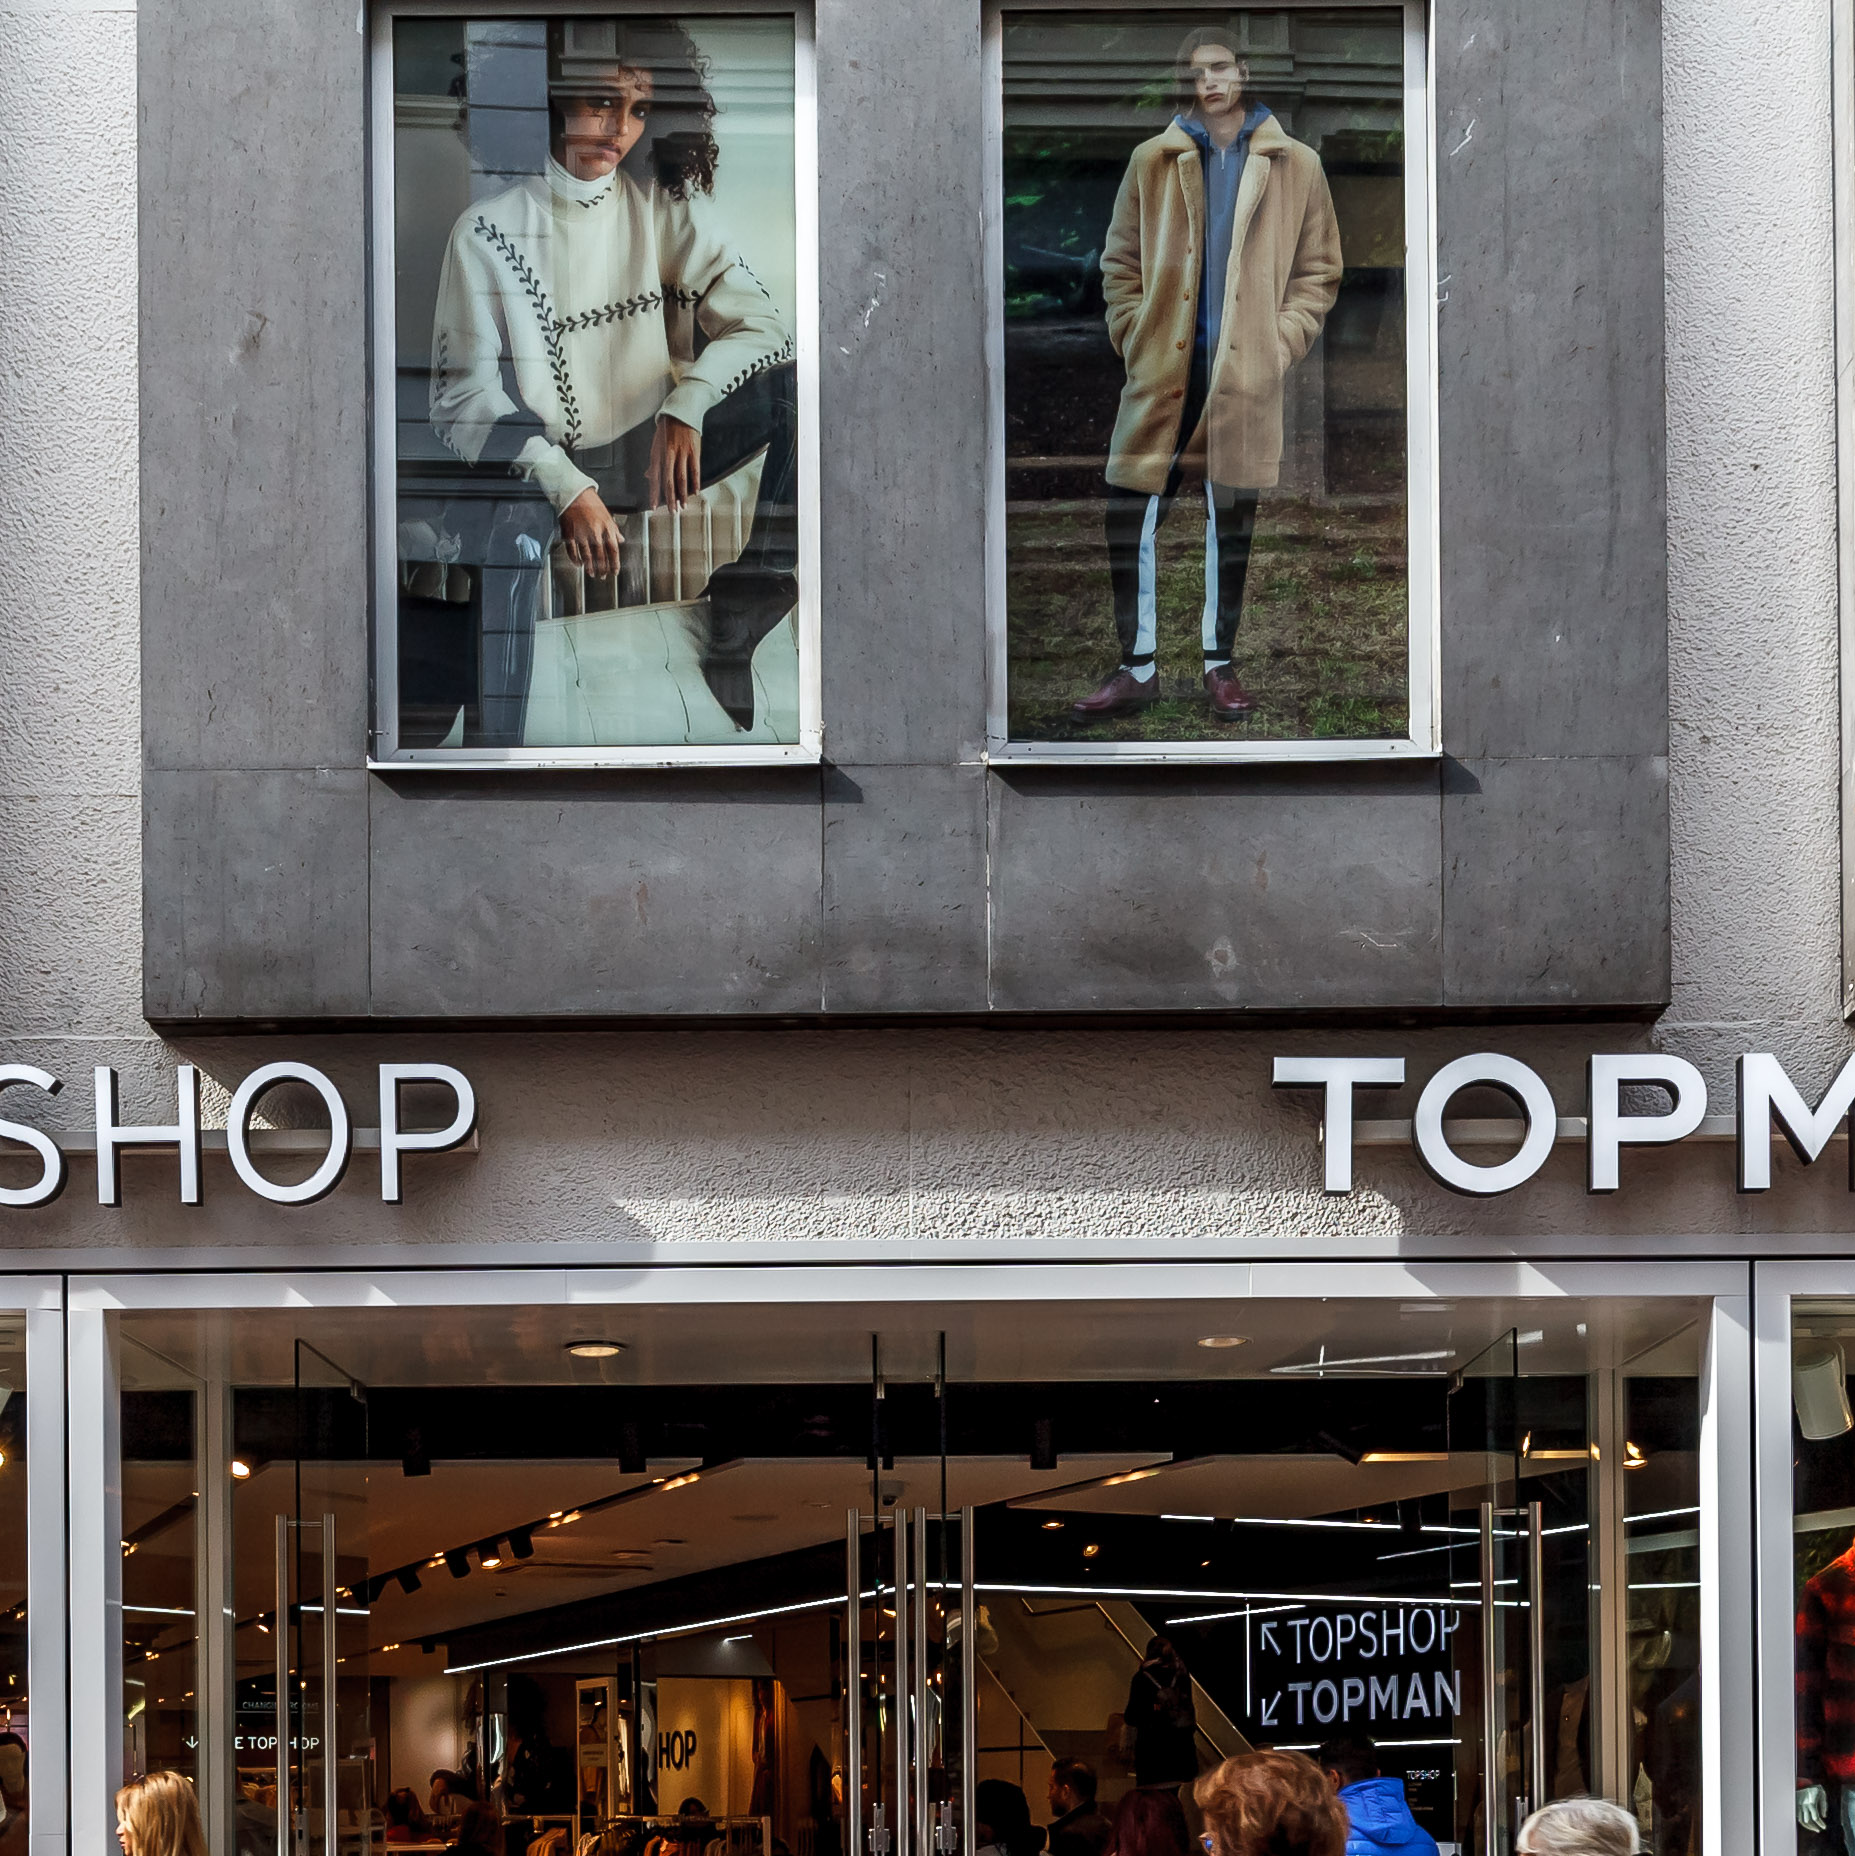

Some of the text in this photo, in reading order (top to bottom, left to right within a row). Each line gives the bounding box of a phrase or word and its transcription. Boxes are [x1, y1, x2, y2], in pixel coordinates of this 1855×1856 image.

[1286, 1607, 1460, 1664] TOPSHOP
[1287, 1670, 1461, 1725] TOPMAN
[247, 1736, 320, 1750] TOPHOP
